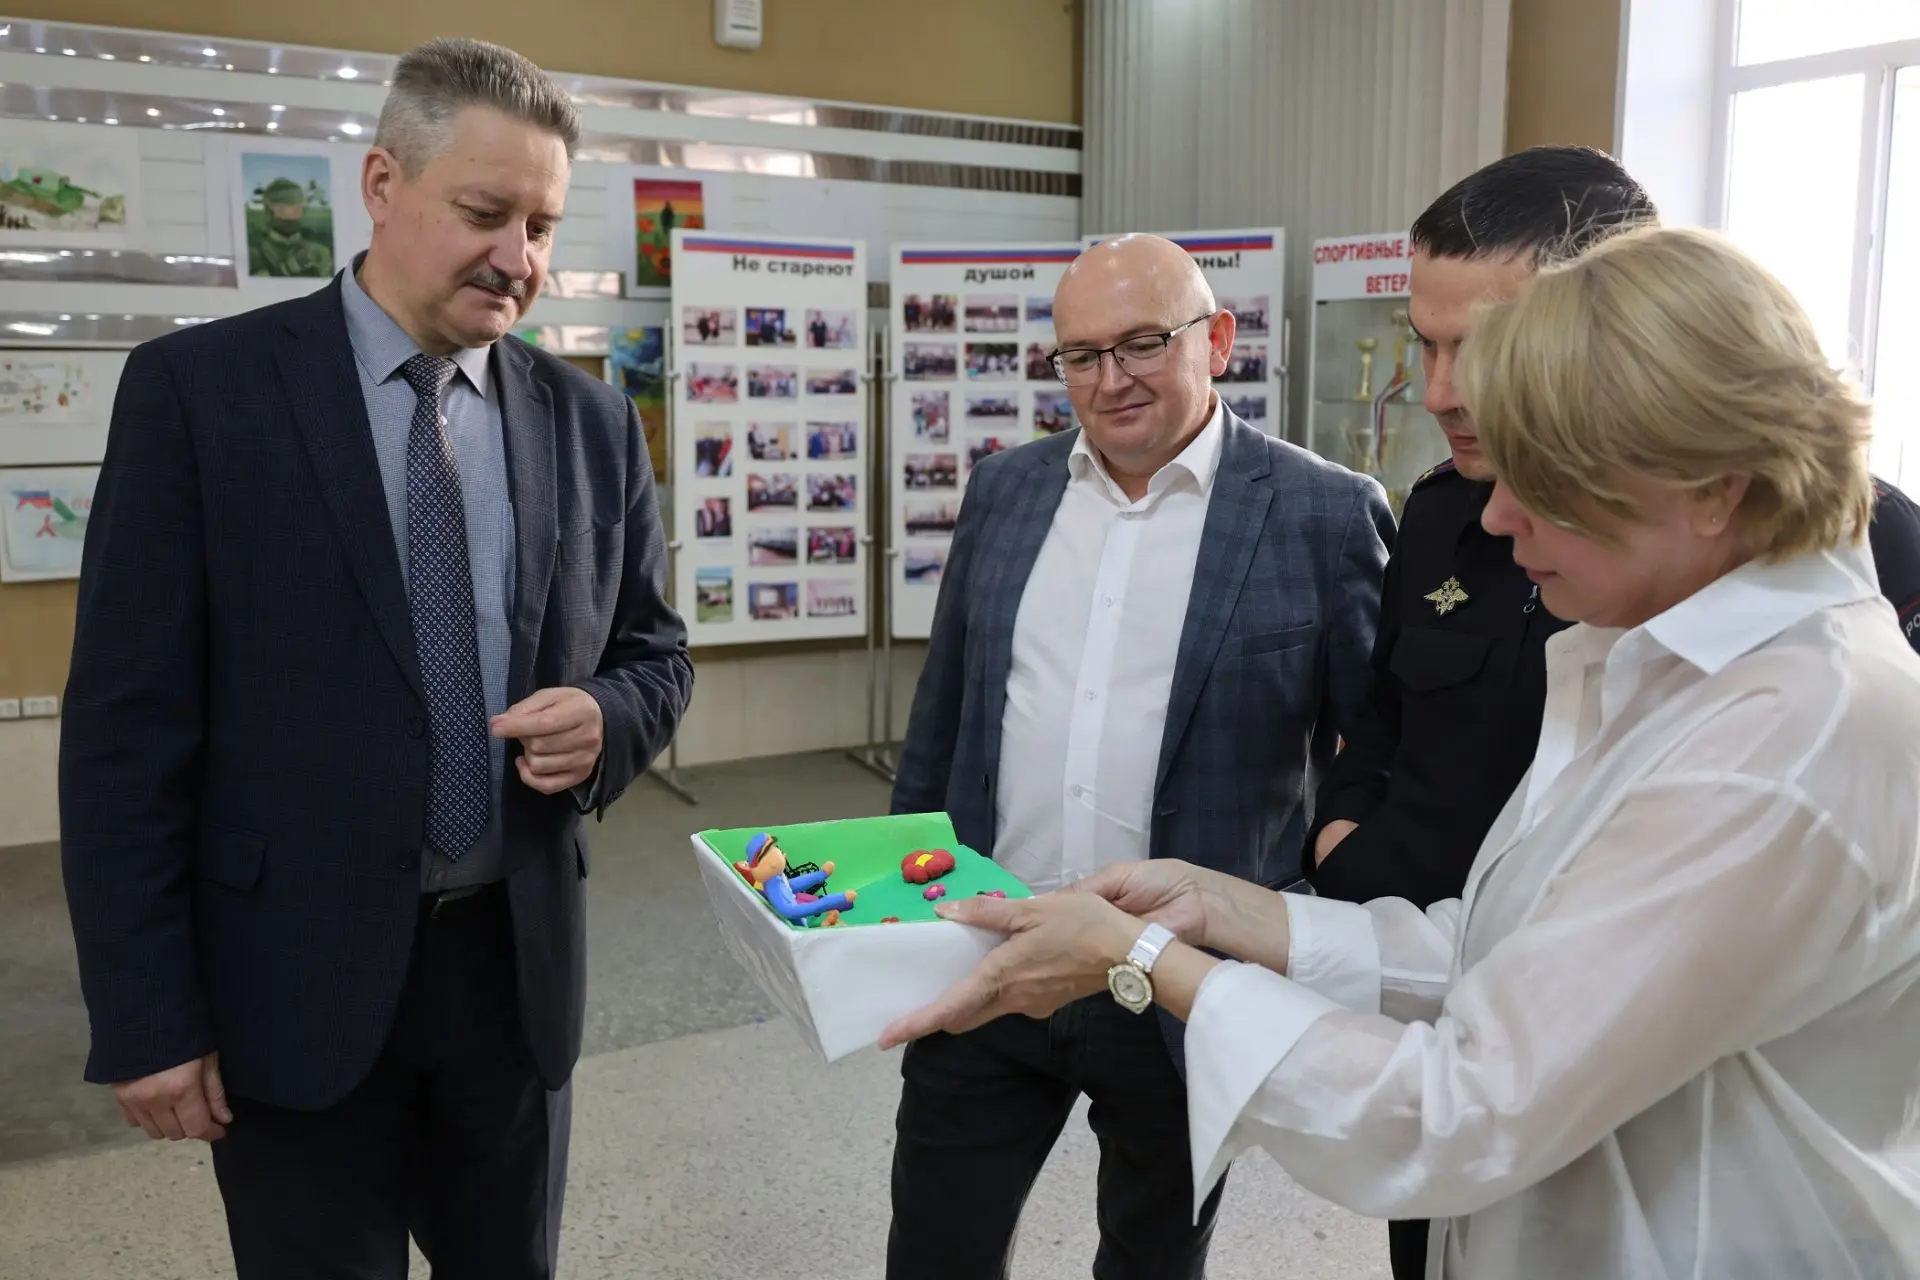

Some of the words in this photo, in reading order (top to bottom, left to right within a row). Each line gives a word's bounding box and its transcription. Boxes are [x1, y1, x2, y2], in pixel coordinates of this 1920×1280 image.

[1315, 240, 1404, 264] СПОРТИВНЫЕ
[732, 254, 760, 272] Не
[767, 260, 854, 278] стареют
[963, 263, 1036, 284] душой
[1366, 273, 1411, 294] ВЕТЕР
